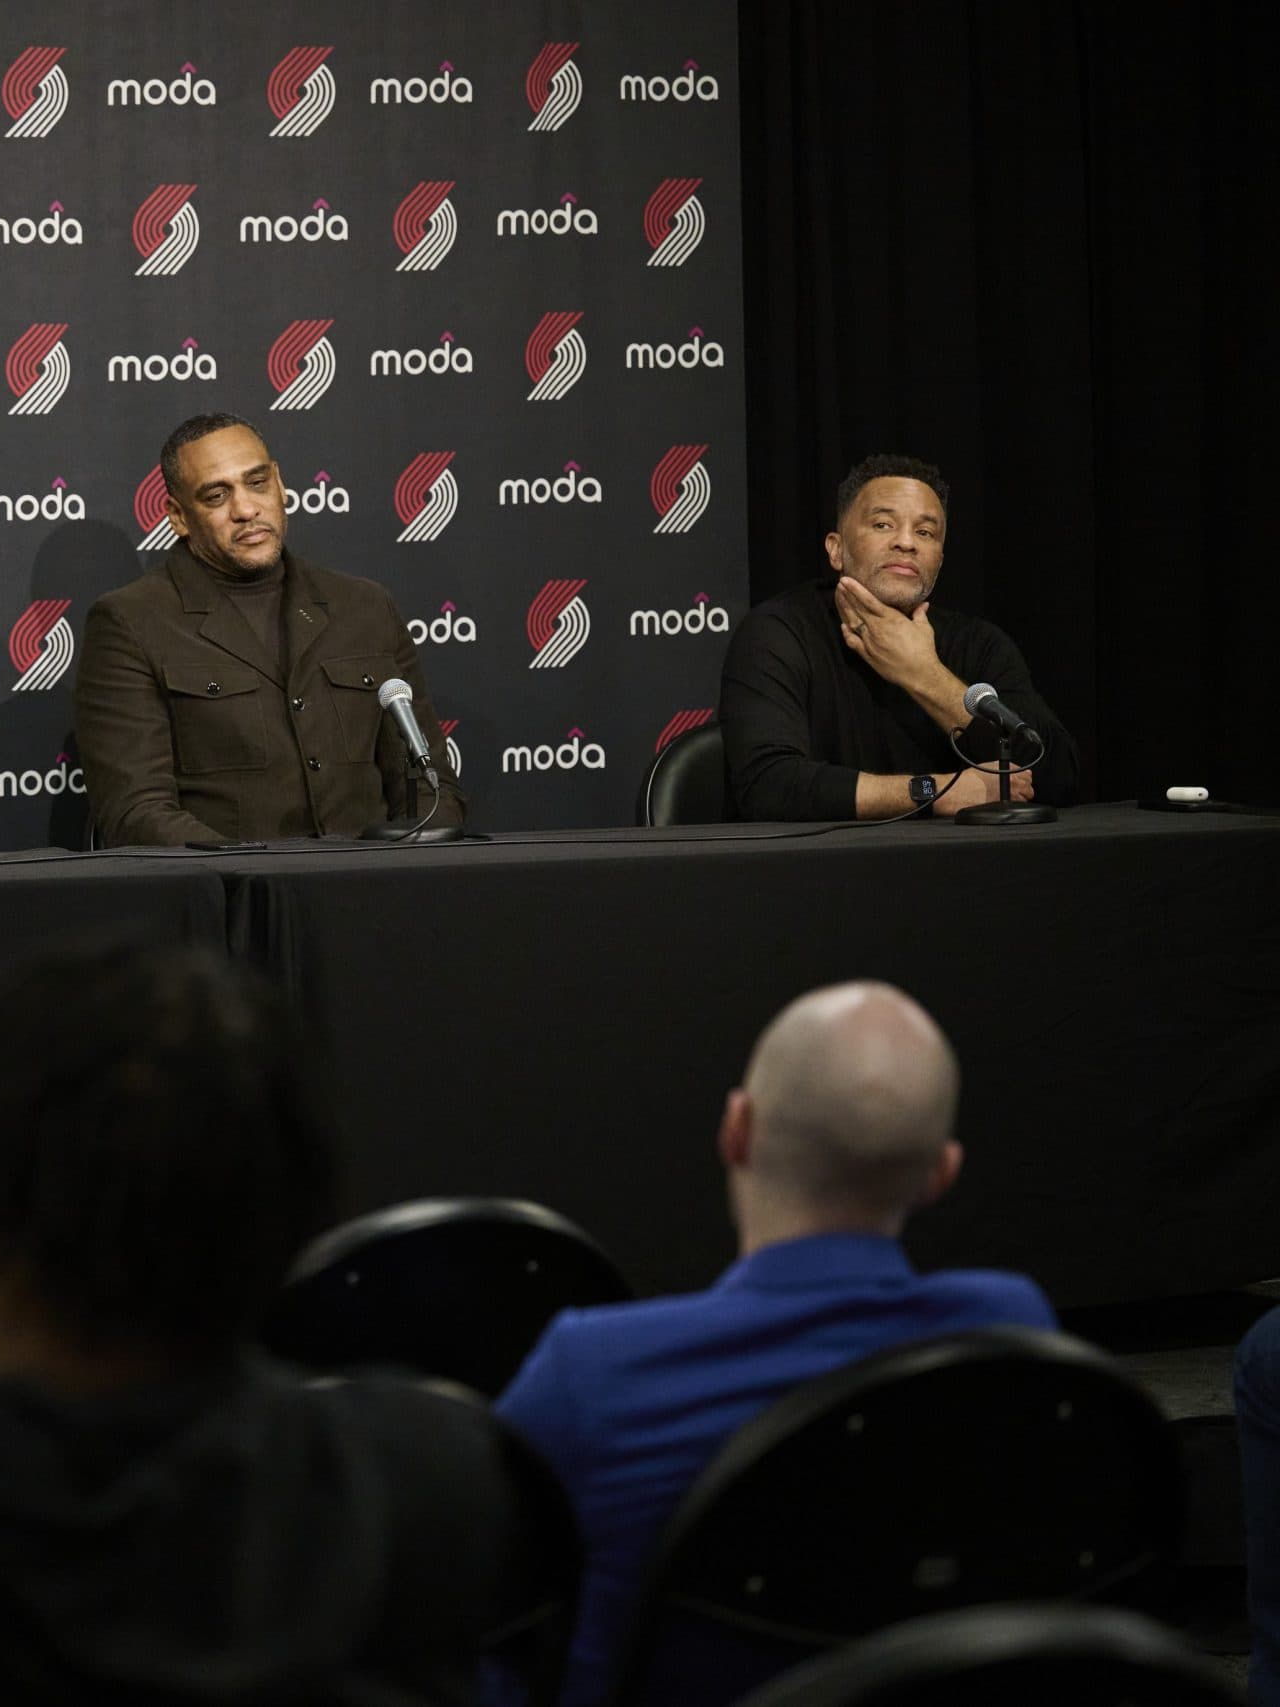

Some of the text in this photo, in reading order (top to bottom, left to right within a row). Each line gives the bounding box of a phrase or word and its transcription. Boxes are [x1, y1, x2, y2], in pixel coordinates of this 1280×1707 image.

[107, 71, 217, 107] moda
[370, 70, 473, 105] moda
[620, 69, 719, 102] moda
[239, 207, 349, 243] moda
[496, 201, 598, 236] moda
[107, 346, 217, 382] moda
[370, 340, 473, 377] moda
[625, 335, 724, 369] moda
[284, 480, 350, 515] oda
[499, 469, 602, 506] moda
[406, 609, 477, 645] oda
[630, 601, 729, 636] moda
[502, 736, 606, 773] moda
